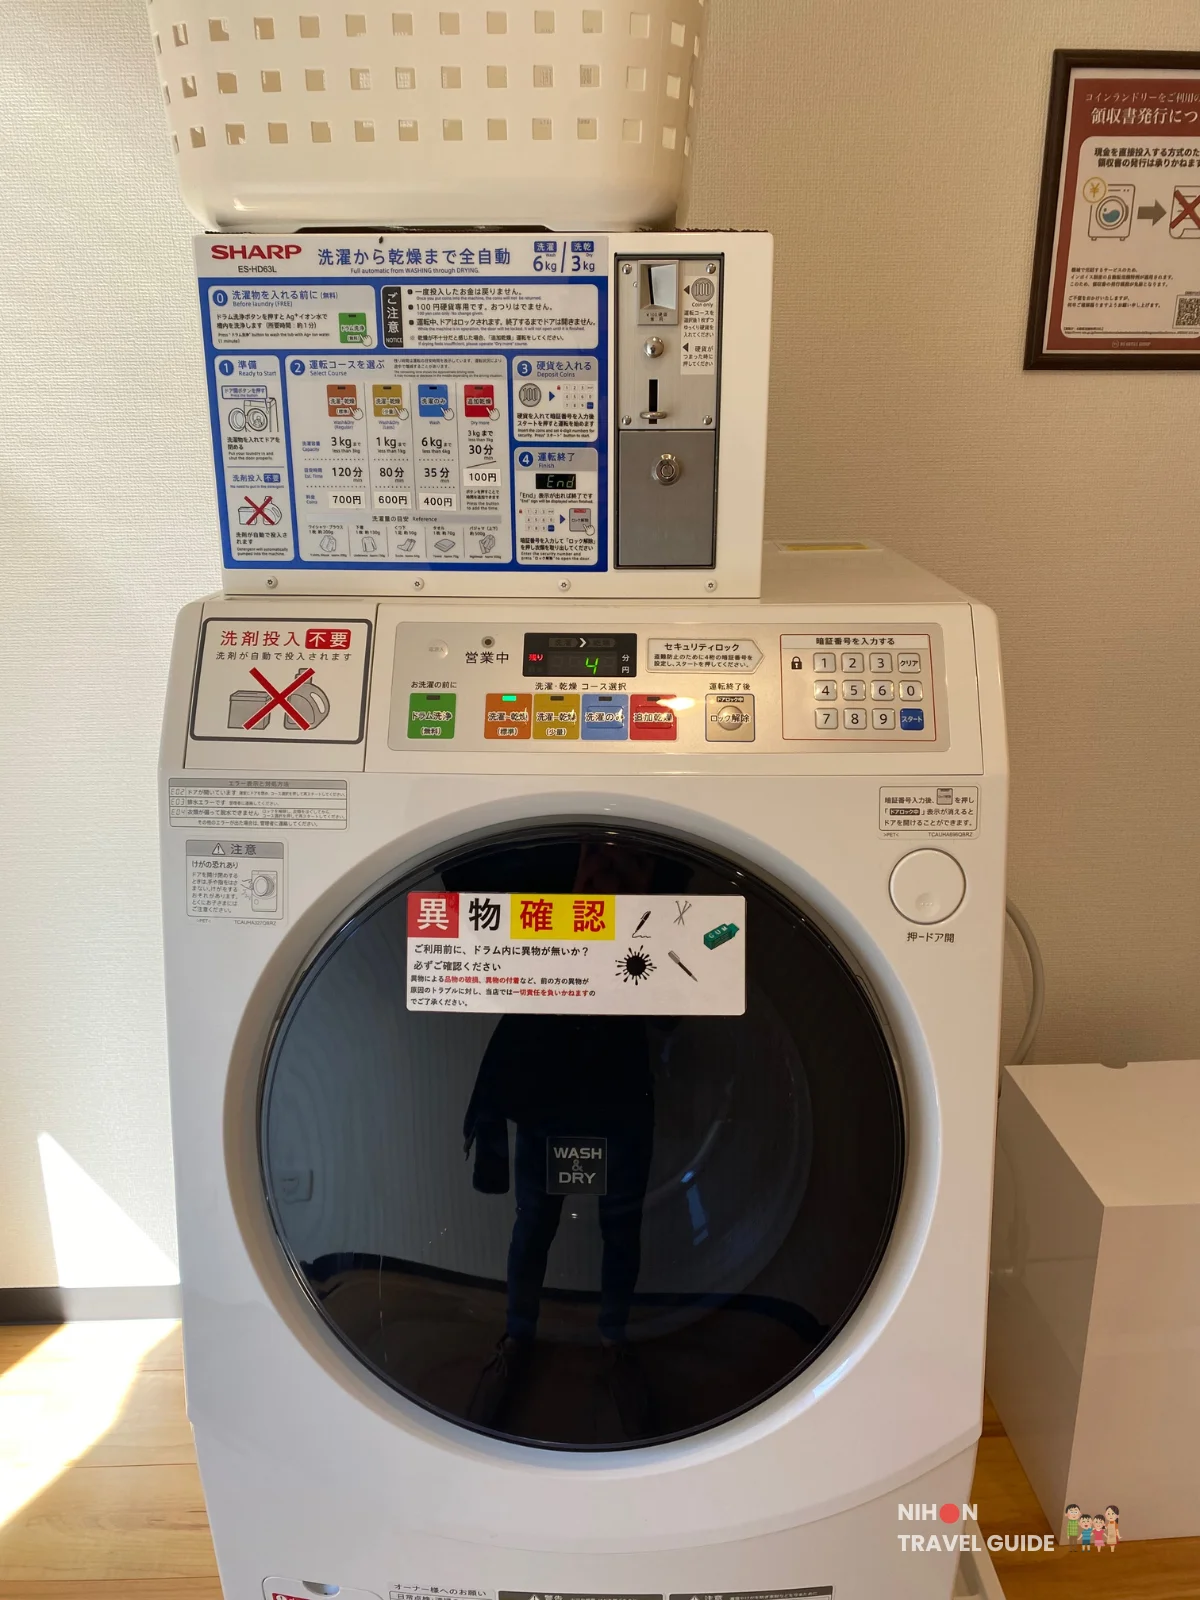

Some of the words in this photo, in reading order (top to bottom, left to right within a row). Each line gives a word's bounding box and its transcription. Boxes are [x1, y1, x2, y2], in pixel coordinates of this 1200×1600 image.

[1090, 107, 1198, 125] 領収書発行につ
[211, 244, 302, 260] SHARP
[317, 248, 511, 266] 洗濯から乾燥まで全自動
[231, 290, 318, 300] 洗濯物を入れる前に
[238, 360, 257, 369] 準備
[309, 359, 385, 370] 運転コースを選ぶ
[536, 360, 592, 371] 硬貨を入れる
[537, 452, 575, 462] 運転終了
[469, 472, 496, 482] 100円
[546, 475, 575, 488] End
[332, 495, 361, 504] 700円
[378, 495, 408, 504] 600円
[424, 497, 453, 507] 400円
[220, 630, 300, 647] 洗剤投入
[308, 632, 349, 648] 不要
[815, 637, 895, 646] 暗証番号を入力する
[664, 643, 740, 651] セキュリティロック
[215, 651, 352, 661] 洗剤が自動で投入されます
[465, 651, 509, 664] 営業中
[621, 654, 630, 662] 分
[585, 657, 599, 675] 4
[821, 658, 827, 668] 1
[849, 658, 857, 668] 2
[877, 658, 885, 668] 3
[621, 666, 630, 674] 円
[581, 682, 627, 691] コース選択
[709, 682, 751, 690] 運転終了後
[821, 685, 830, 696] 4
[850, 686, 857, 696] 5
[878, 685, 887, 696] 6
[710, 714, 750, 722] ロック解除
[823, 713, 831, 724] 7
[851, 713, 859, 724] 8
[879, 713, 888, 724] 9
[231, 844, 257, 855] 注意
[191, 861, 239, 869] けがの恐れあり
[413, 960, 501, 971] 必ずご確認ください
[553, 1147, 602, 1159] WASH
[572, 1159, 583, 1172] &
[559, 1171, 597, 1184] DRY
